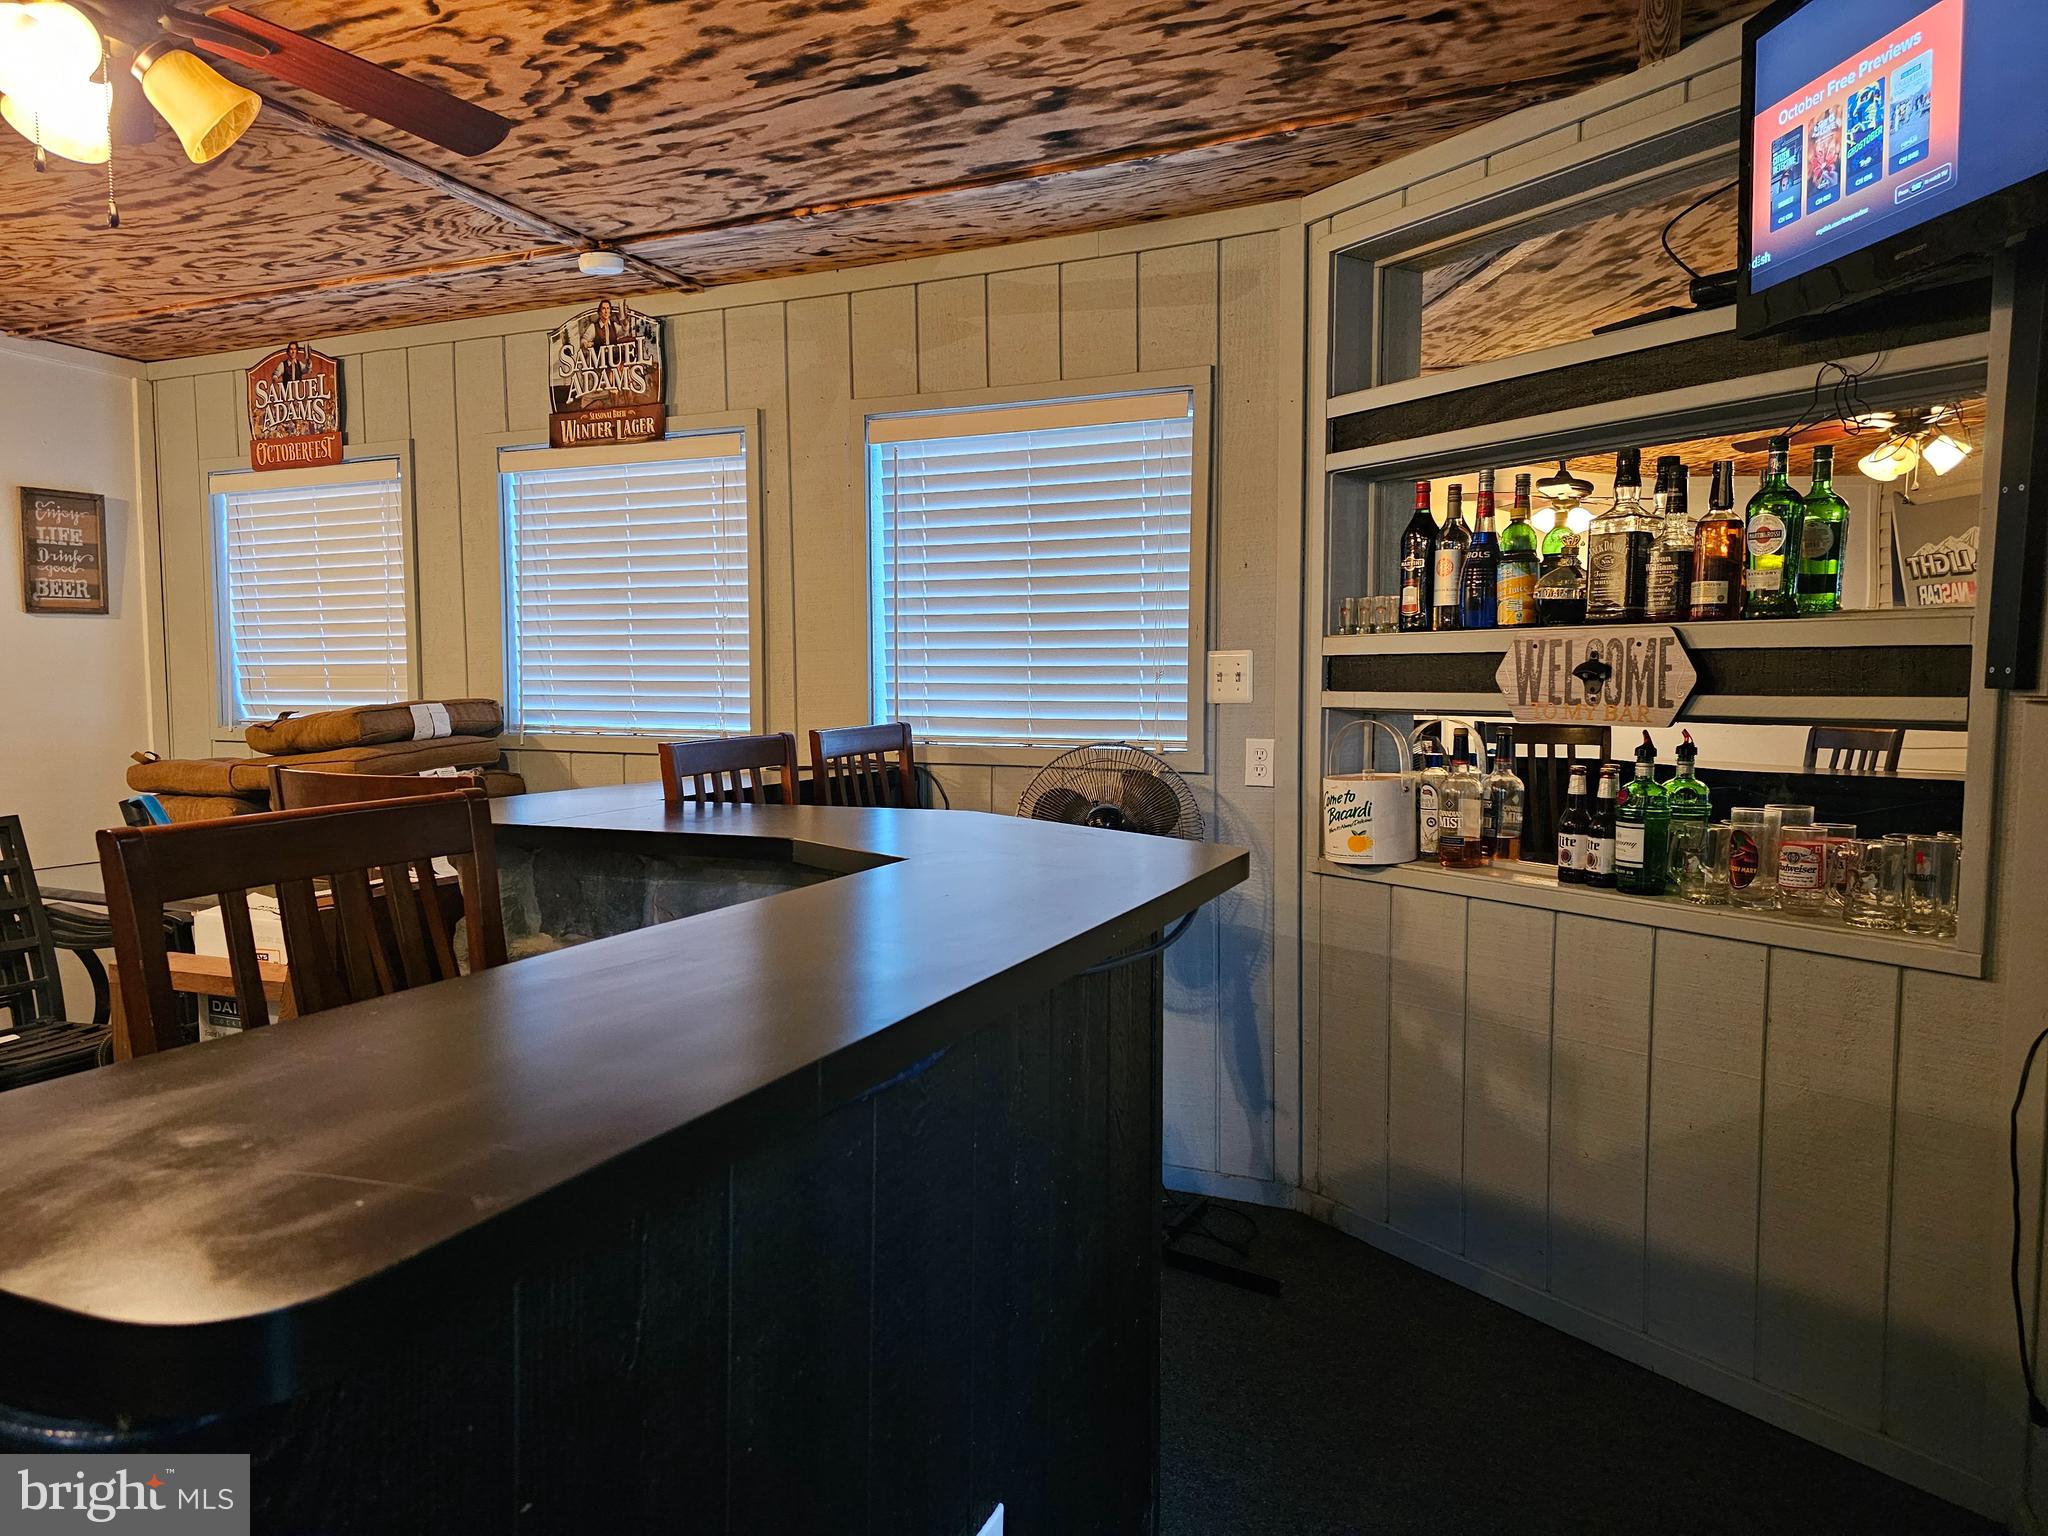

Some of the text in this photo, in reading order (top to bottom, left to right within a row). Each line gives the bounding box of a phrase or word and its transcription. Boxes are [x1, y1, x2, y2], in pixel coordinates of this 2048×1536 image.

[1779, 91, 1824, 126] October
[1828, 71, 1856, 97] Free
[1859, 31, 1922, 78] Previews
[1751, 251, 1771, 269] dish
[559, 336, 653, 377] SAMUEL
[256, 374, 330, 409] SAMUEL
[566, 365, 646, 405] ADAMS
[263, 398, 326, 431] ADAMS
[561, 417, 655, 443] WINTER LAGER
[257, 435, 334, 465] OCTOBERFEST
[35, 500, 90, 525] Enjoy
[36, 527, 83, 546] LIFE
[38, 547, 94, 563] Drink
[37, 561, 84, 577] good
[33, 578, 90, 600] BEER
[1513, 638, 1674, 708] WELCOME
[1533, 703, 1653, 722] TO MY BAR
[1324, 790, 1355, 809] Come to
[1328, 800, 1372, 826] Bacardi
[1439, 816, 1463, 829] MIST
[1560, 835, 1576, 848] Lite
[212, 1000, 240, 1015] DAI
